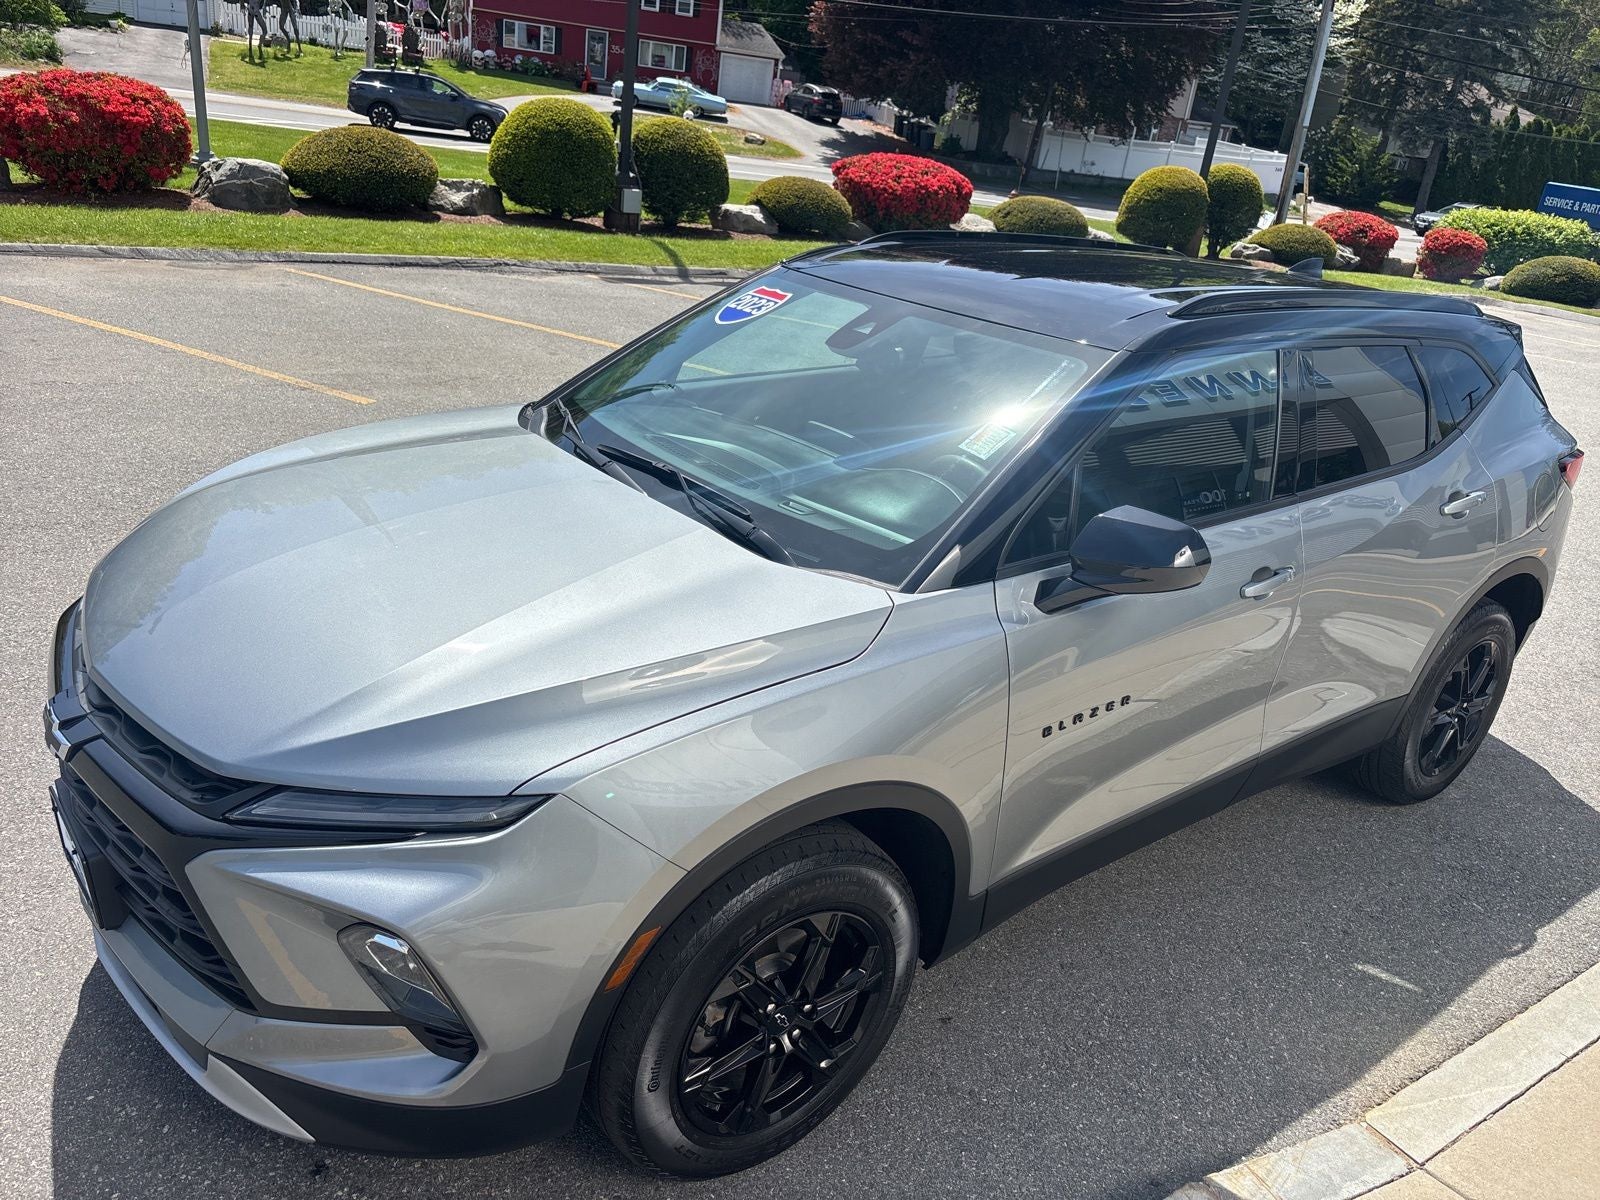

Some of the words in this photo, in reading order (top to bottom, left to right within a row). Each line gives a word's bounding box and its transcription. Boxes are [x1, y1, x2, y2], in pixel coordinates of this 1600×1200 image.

[1543, 195, 1574, 211] SERVICE
[1573, 201, 1580, 211] &
[1580, 202, 1600, 215] PART
[729, 294, 774, 315] 2023
[1042, 694, 1131, 738] BLAZER
[647, 1031, 670, 1093] Continen
